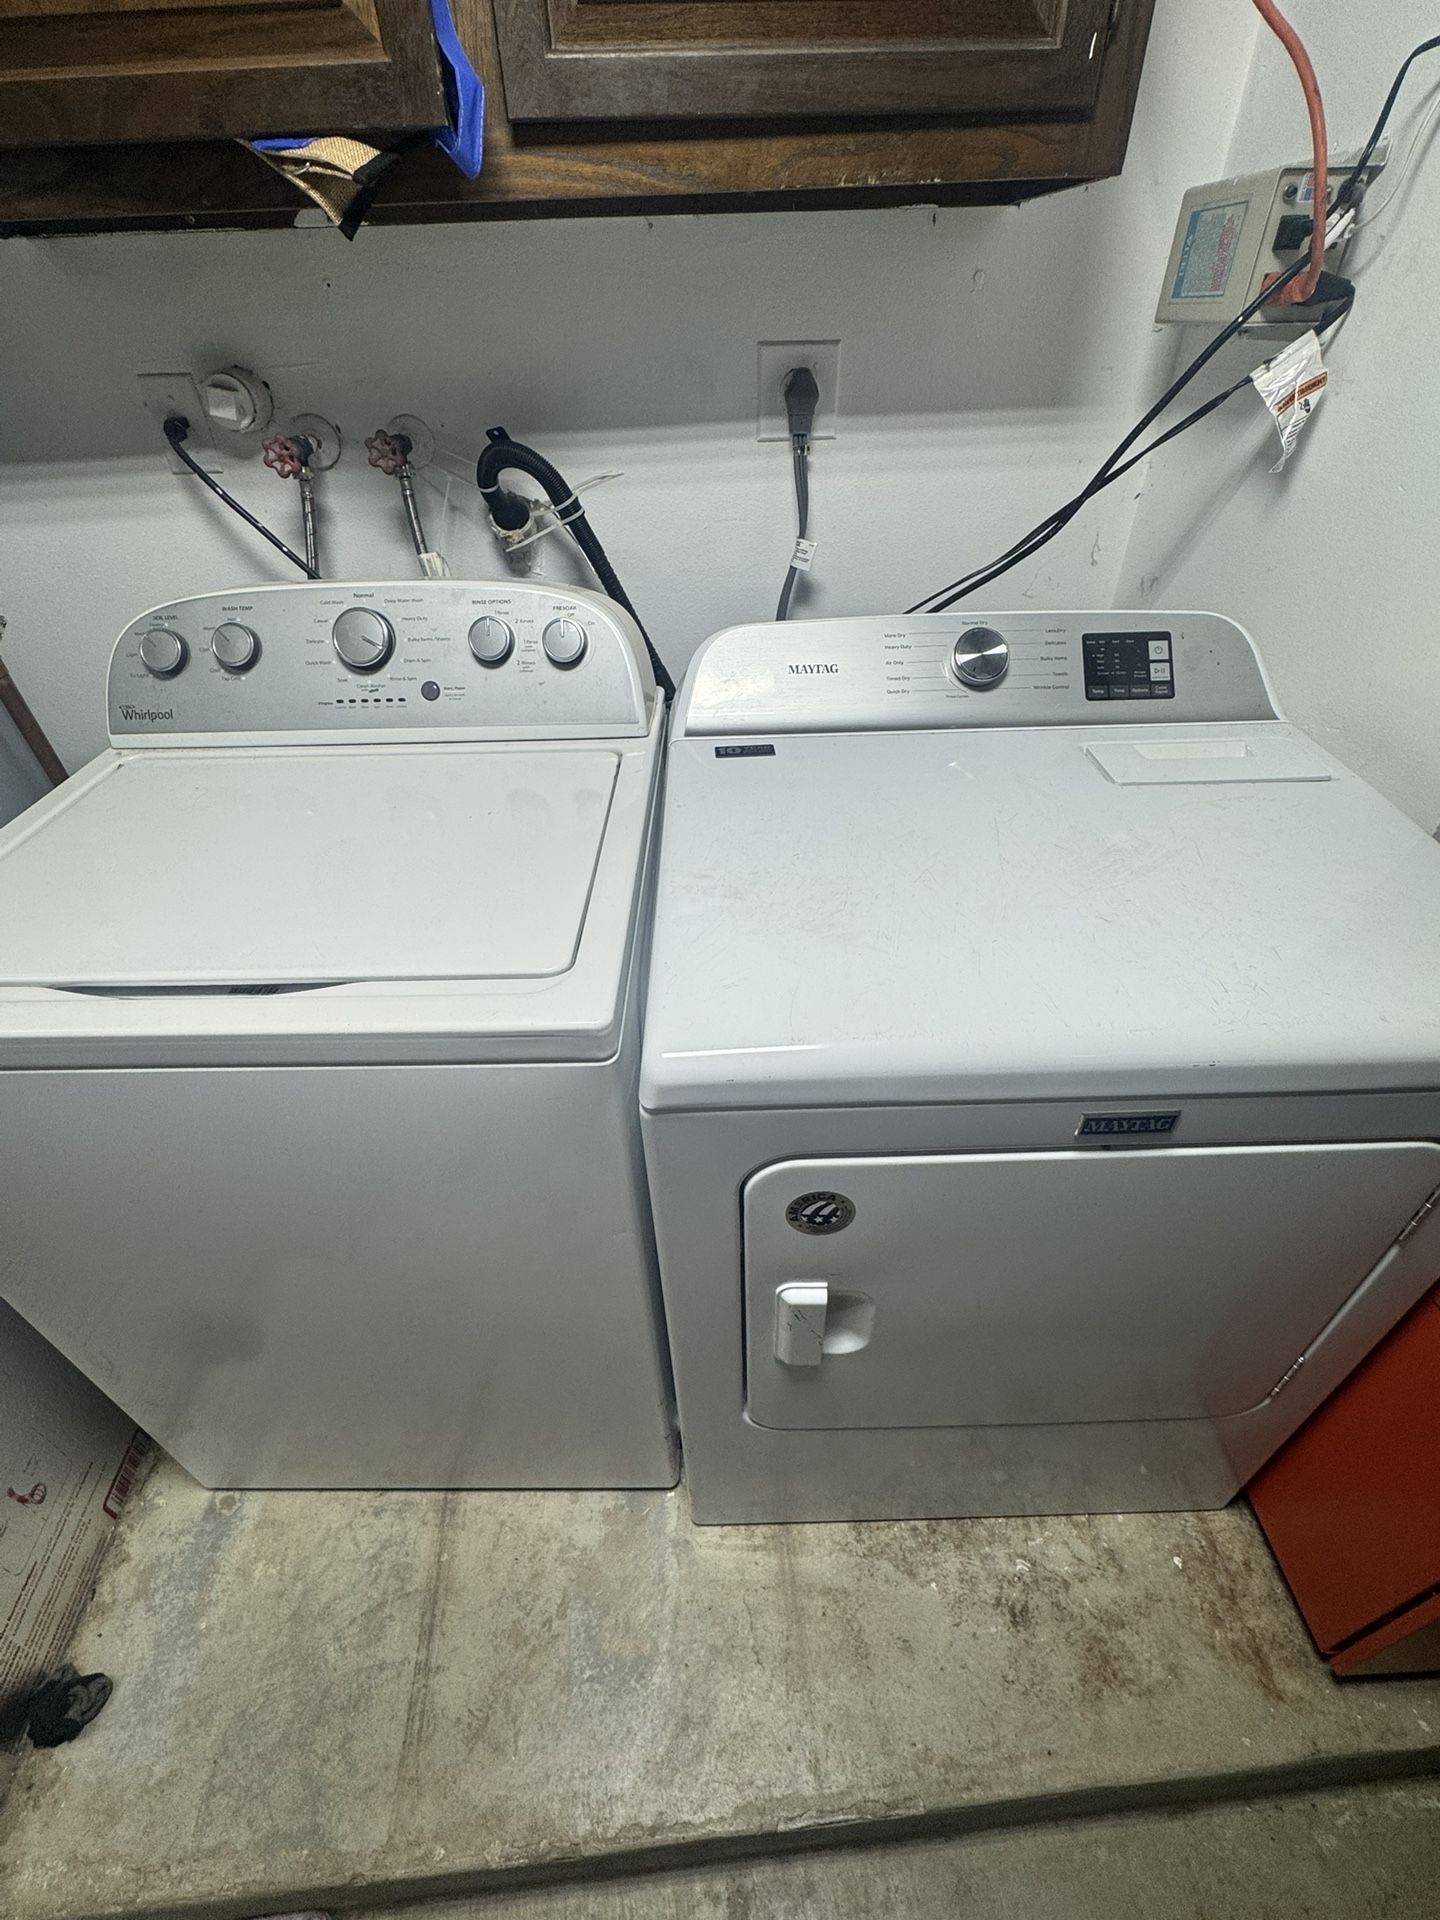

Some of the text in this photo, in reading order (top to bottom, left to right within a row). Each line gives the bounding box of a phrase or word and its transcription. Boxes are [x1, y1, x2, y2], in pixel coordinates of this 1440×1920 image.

[788, 664, 839, 674] MAYTAG
[121, 708, 174, 722] Whirlpool
[1083, 1118, 1171, 1132] MAYTAG
[788, 1192, 836, 1222] AMERICA
